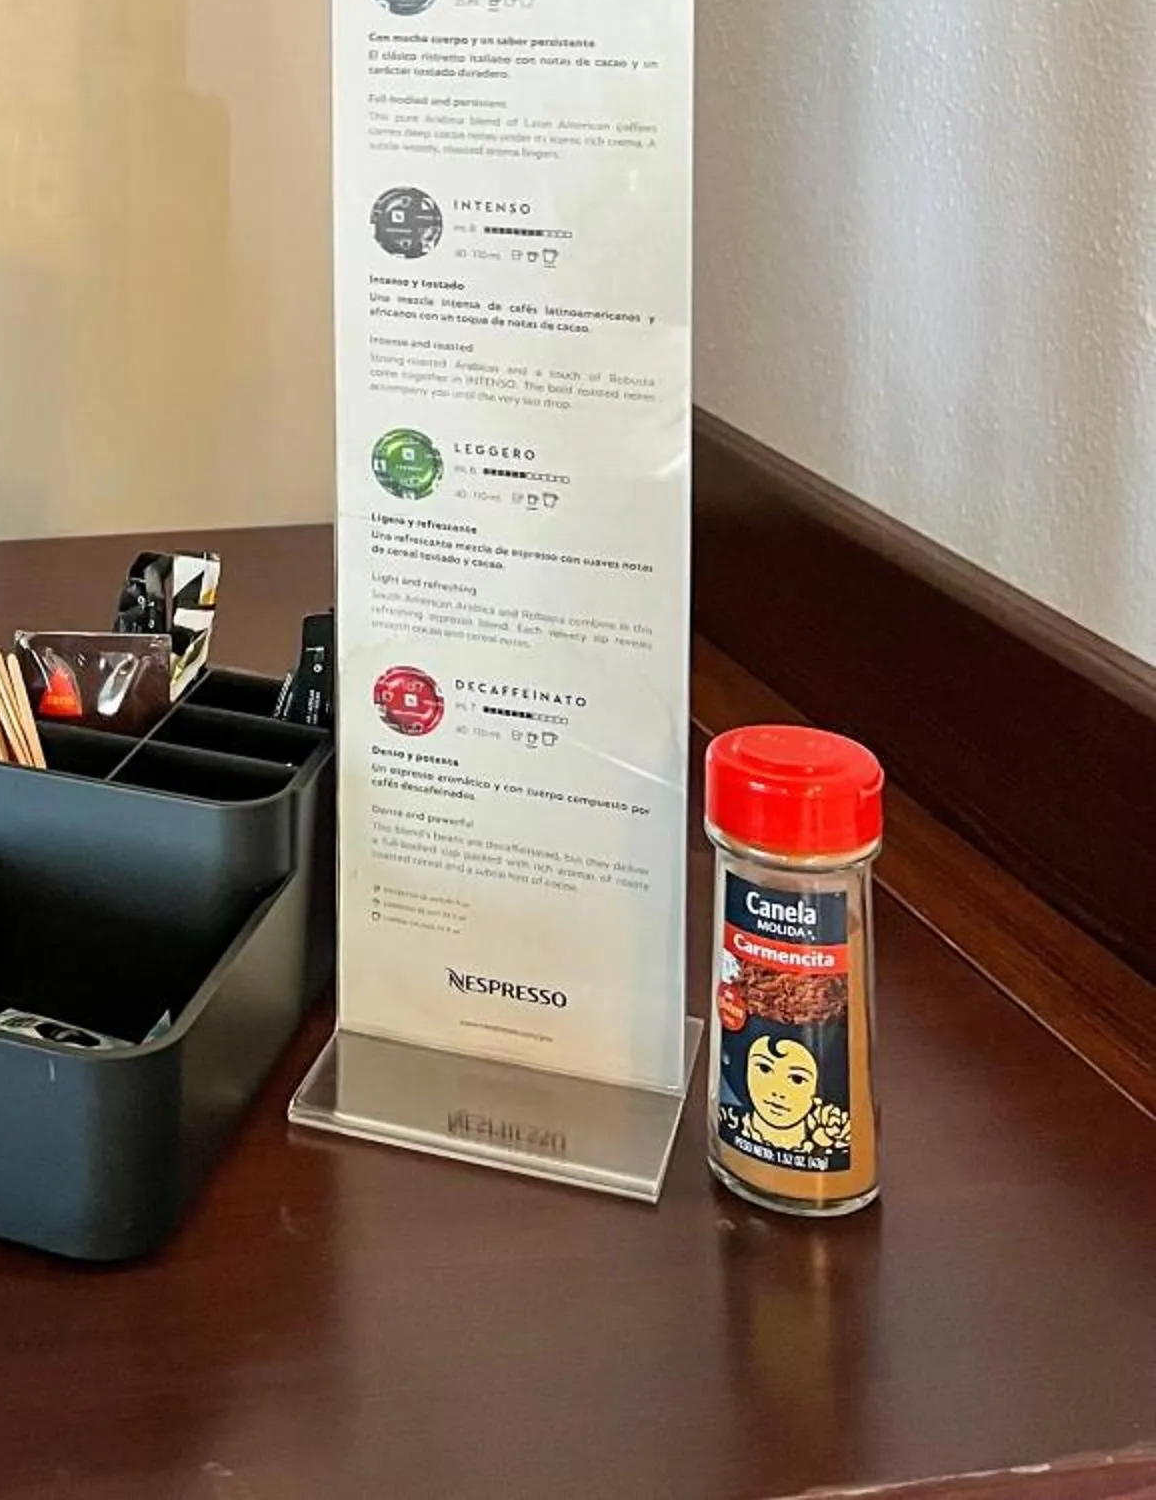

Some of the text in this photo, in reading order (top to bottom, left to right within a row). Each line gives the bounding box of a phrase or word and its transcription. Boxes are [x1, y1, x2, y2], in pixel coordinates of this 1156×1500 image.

[431, 36, 469, 46] cuerpo
[381, 50, 417, 61] clásico
[575, 57, 591, 67] de
[594, 59, 628, 68] cacao
[631, 60, 639, 70] y
[453, 199, 532, 215] INTENSO
[411, 279, 419, 289] y
[421, 279, 466, 291] tostado
[369, 306, 418, 319] africanos
[456, 314, 489, 326] toque
[487, 300, 503, 312] de
[509, 302, 538, 315] cafés
[545, 304, 642, 323] latinoamericanos
[453, 442, 537, 462] LEGGERO
[407, 518, 415, 529] y
[416, 519, 478, 535] refrescante
[387, 546, 418, 560] cereal
[394, 533, 453, 550] refrescante
[560, 554, 581, 565] con
[621, 561, 653, 574] notas
[423, 579, 477, 597] refreshing
[454, 678, 588, 709] DECAFFEINATO
[371, 777, 400, 790] cafés
[493, 783, 501, 793] y
[503, 783, 524, 794] con
[526, 787, 565, 802] cuerpo
[566, 794, 629, 812] compuesto
[745, 891, 817, 925] Canela
[757, 919, 805, 938] MOLIDA
[732, 933, 836, 968] Carmencita
[445, 967, 567, 1009] NESPRESSO
